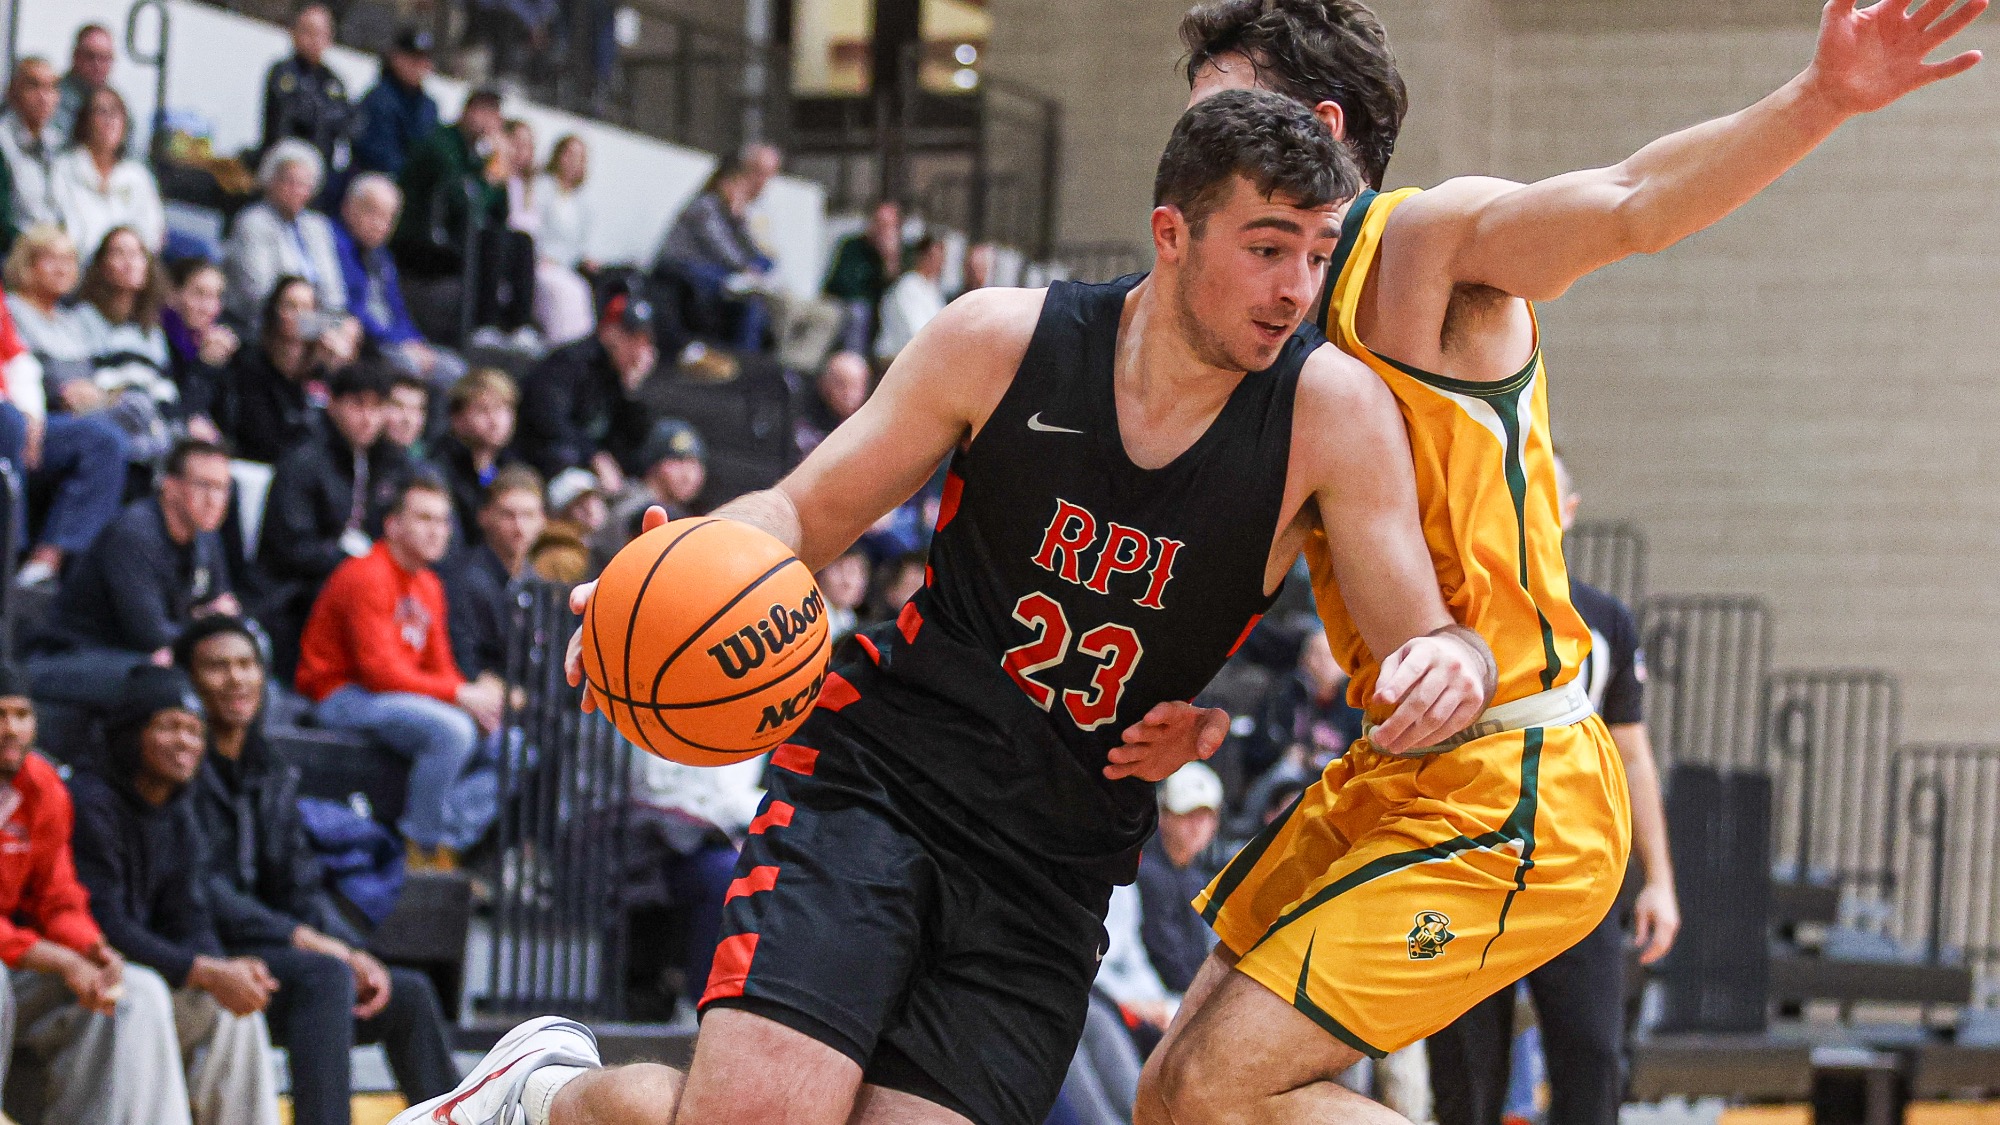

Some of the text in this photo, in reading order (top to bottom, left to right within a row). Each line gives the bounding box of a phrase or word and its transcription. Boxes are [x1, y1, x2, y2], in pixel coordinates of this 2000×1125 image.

[1031, 498, 1186, 609] RPI
[707, 584, 825, 680] Wilson
[1001, 591, 1144, 732] 23
